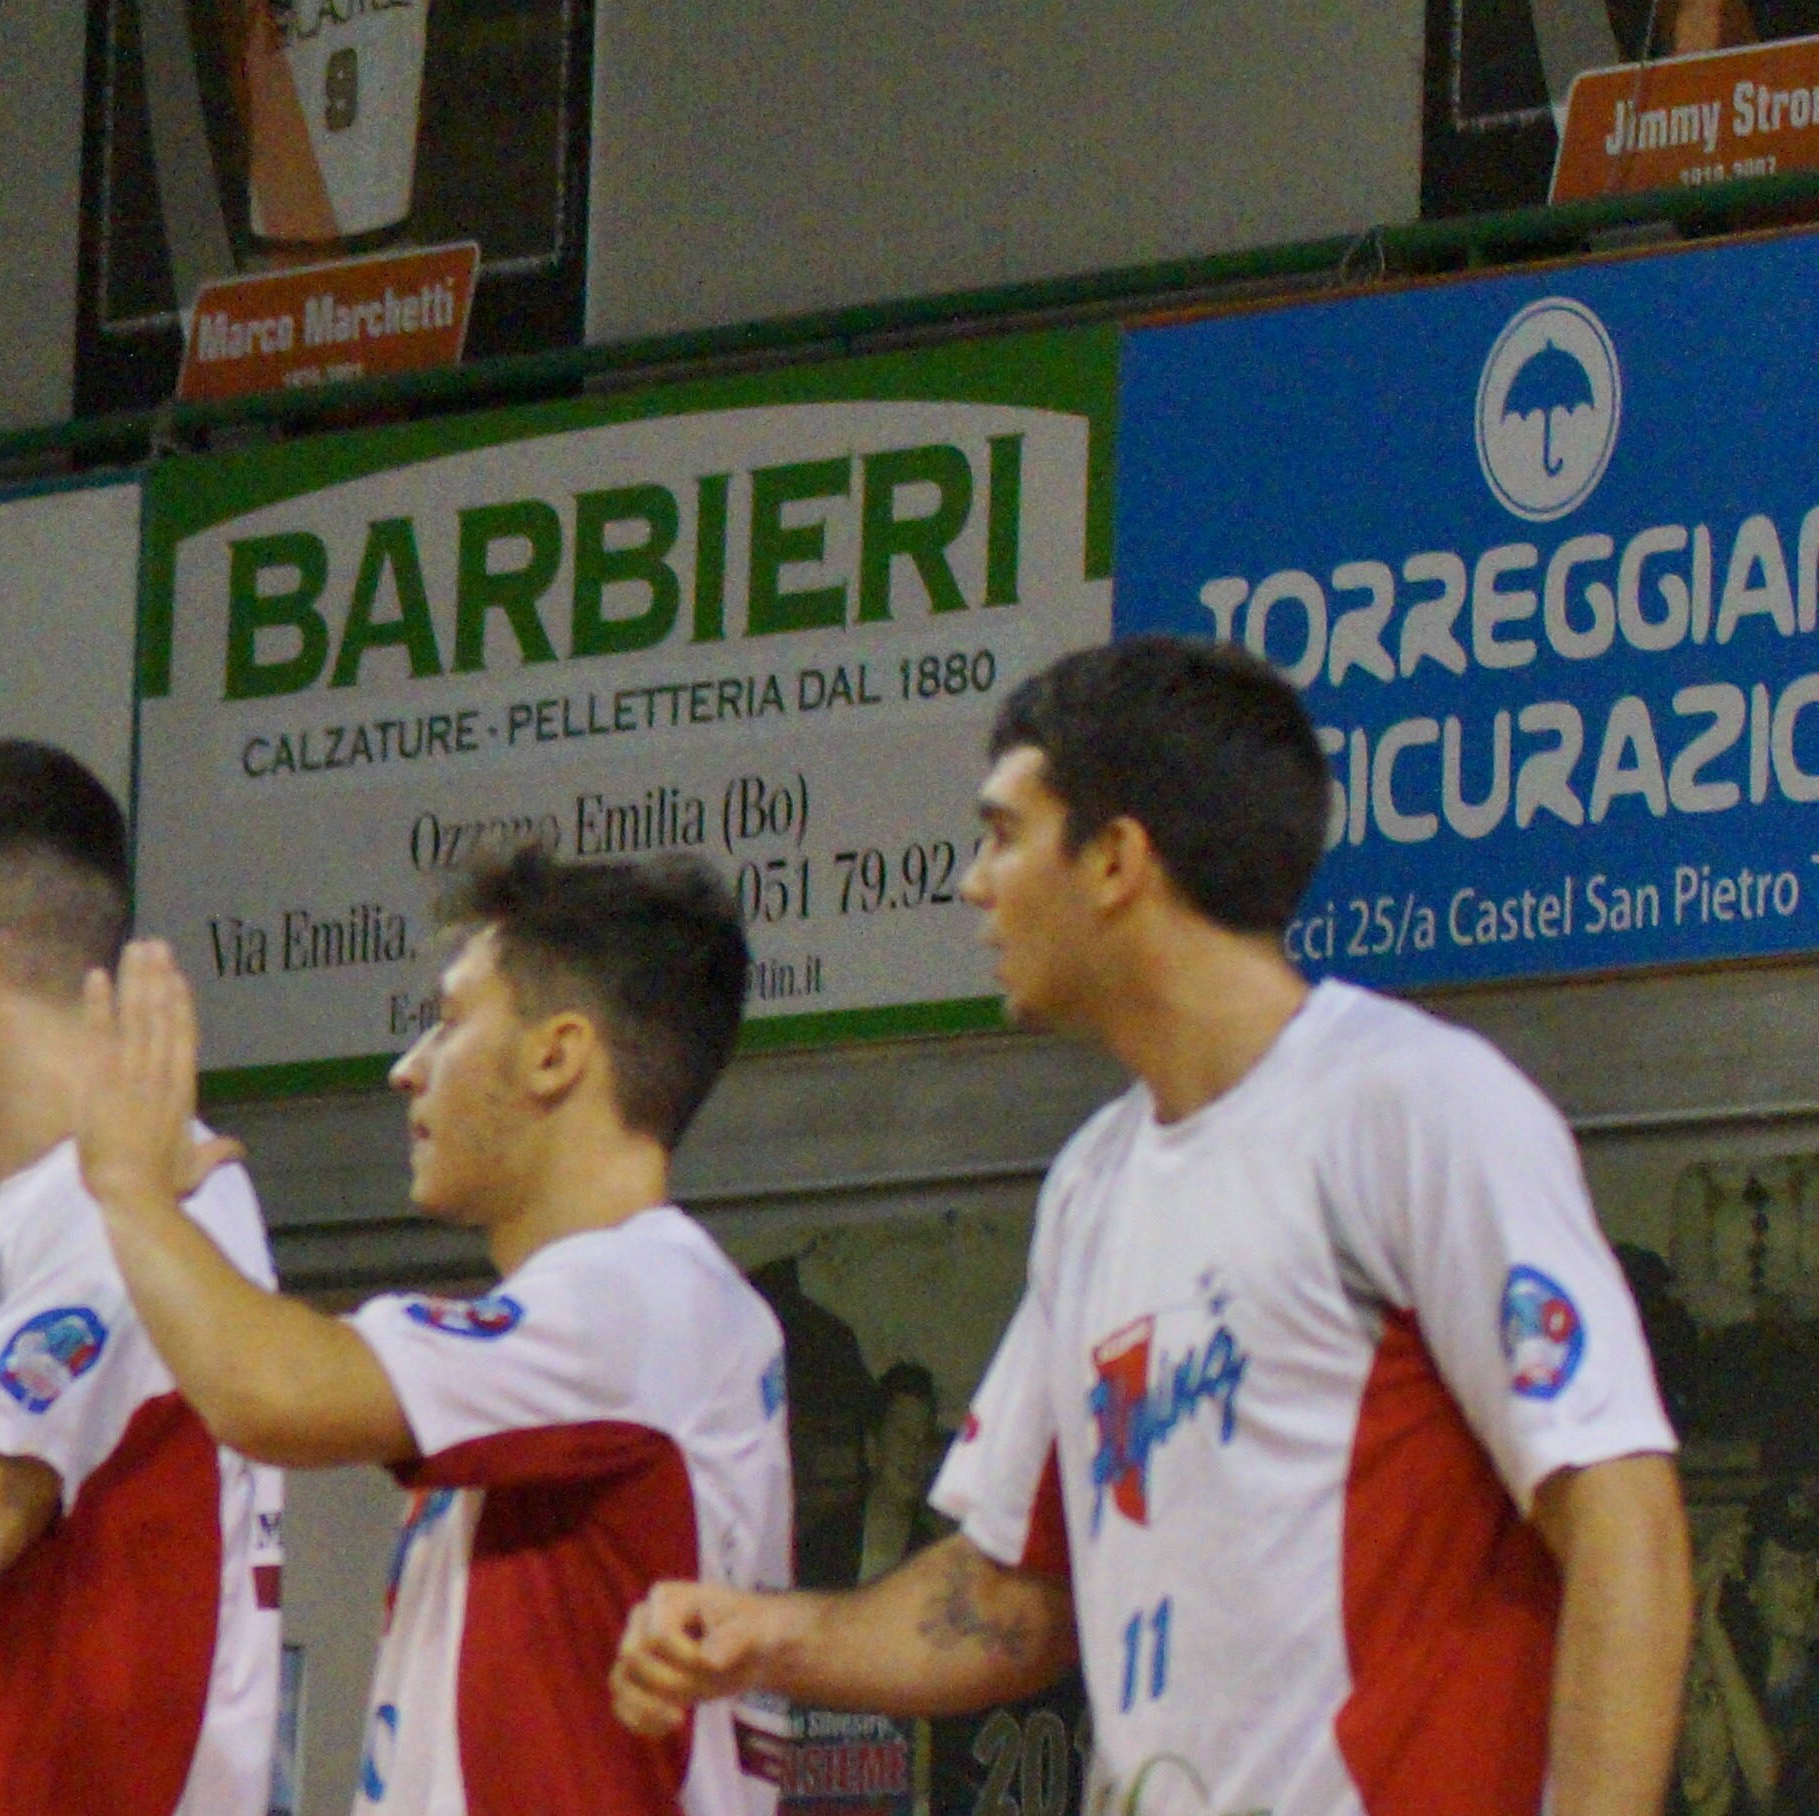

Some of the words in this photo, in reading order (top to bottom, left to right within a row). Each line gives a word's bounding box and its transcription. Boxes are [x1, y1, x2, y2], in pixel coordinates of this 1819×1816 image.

[1605, 100, 1721, 156] Jimmy
[197, 308, 293, 363] Marco
[304, 277, 457, 347] Marchetti
[221, 432, 1027, 702] BARBIERI
[1199, 504, 1819, 691] TORREGGIA
[241, 710, 479, 778] CALZATURE
[506, 676, 786, 749] PELLETTERIA
[798, 664, 884, 713] DAL
[898, 648, 998, 703] 1880
[575, 792, 706, 857] Emilia
[721, 772, 810, 855] (Bo)
[737, 858, 812, 922] 051
[1346, 892, 1437, 958] 25/a
[1448, 875, 1572, 946] Castel
[1584, 873, 1661, 935] San
[1673, 863, 1801, 926] Pietro
[207, 915, 269, 980] Via
[1120, 1593, 1174, 1715] 11
